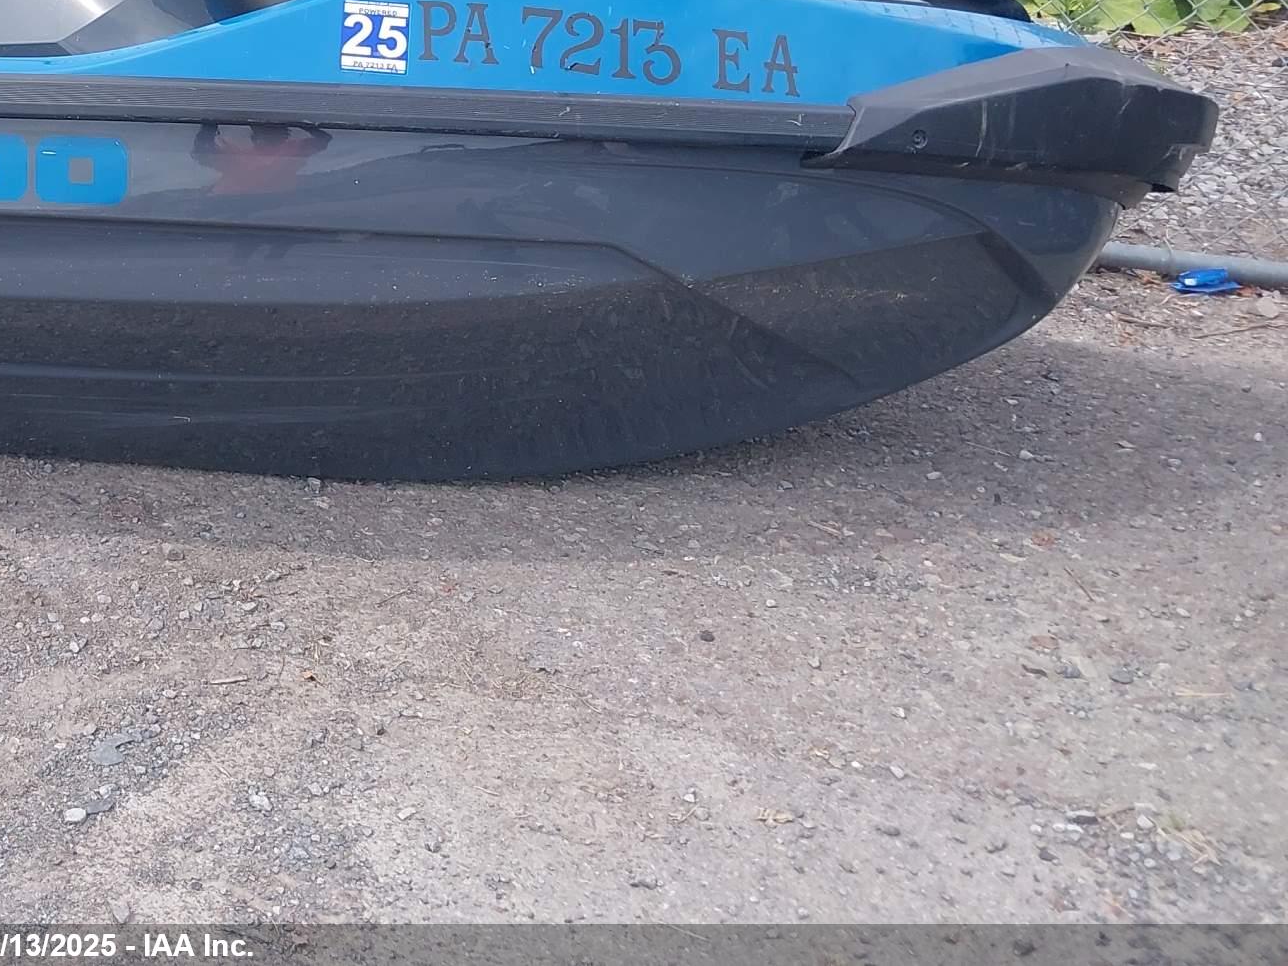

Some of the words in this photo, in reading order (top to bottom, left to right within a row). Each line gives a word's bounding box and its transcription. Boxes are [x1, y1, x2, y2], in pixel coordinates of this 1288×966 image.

[341, 14, 407, 58] 25
[417, 0, 499, 65] PA
[521, 6, 682, 86] 7213
[712, 29, 800, 97] EA
